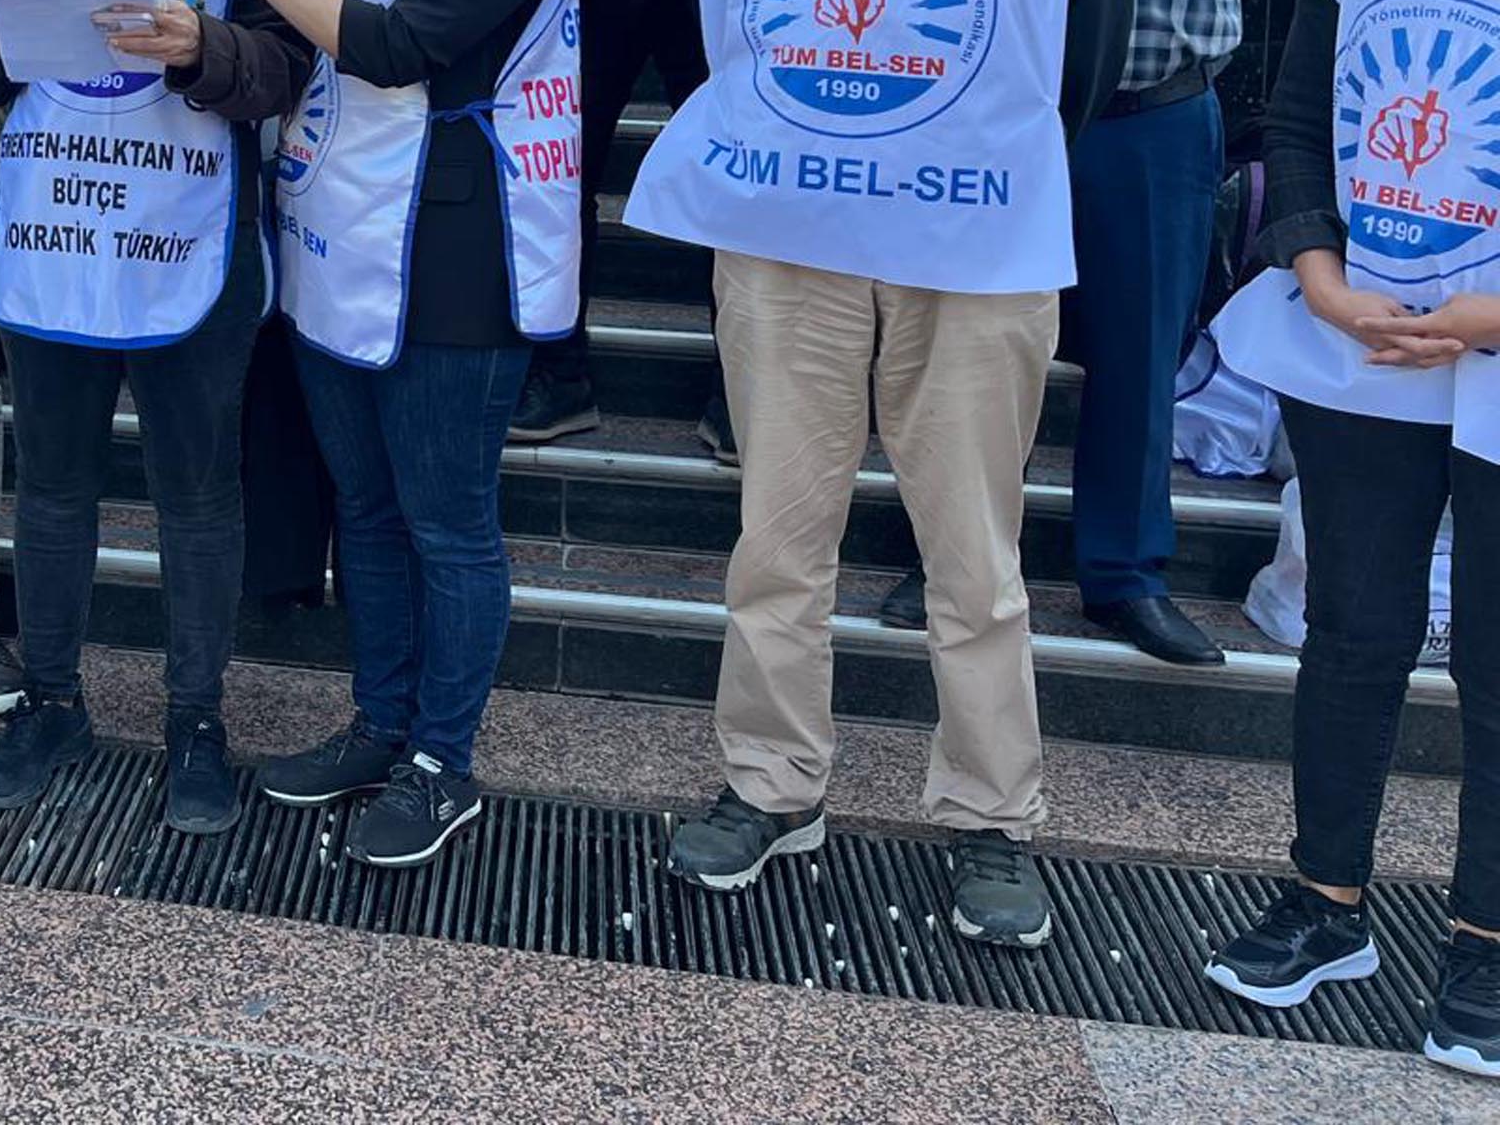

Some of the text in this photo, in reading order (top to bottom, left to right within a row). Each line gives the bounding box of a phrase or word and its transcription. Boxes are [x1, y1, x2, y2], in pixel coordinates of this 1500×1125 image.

[1367, 4, 1500, 40] Yönetim Hizme
[772, 44, 945, 77] TÜM BEL-SEN
[815, 78, 880, 101] 1990
[700, 138, 1010, 206] TÜM BEL-SEN
[53, 172, 127, 215] BÜTÇE
[1377, 185, 1498, 227] BEL-SEN
[1362, 214, 1423, 245] 1990
